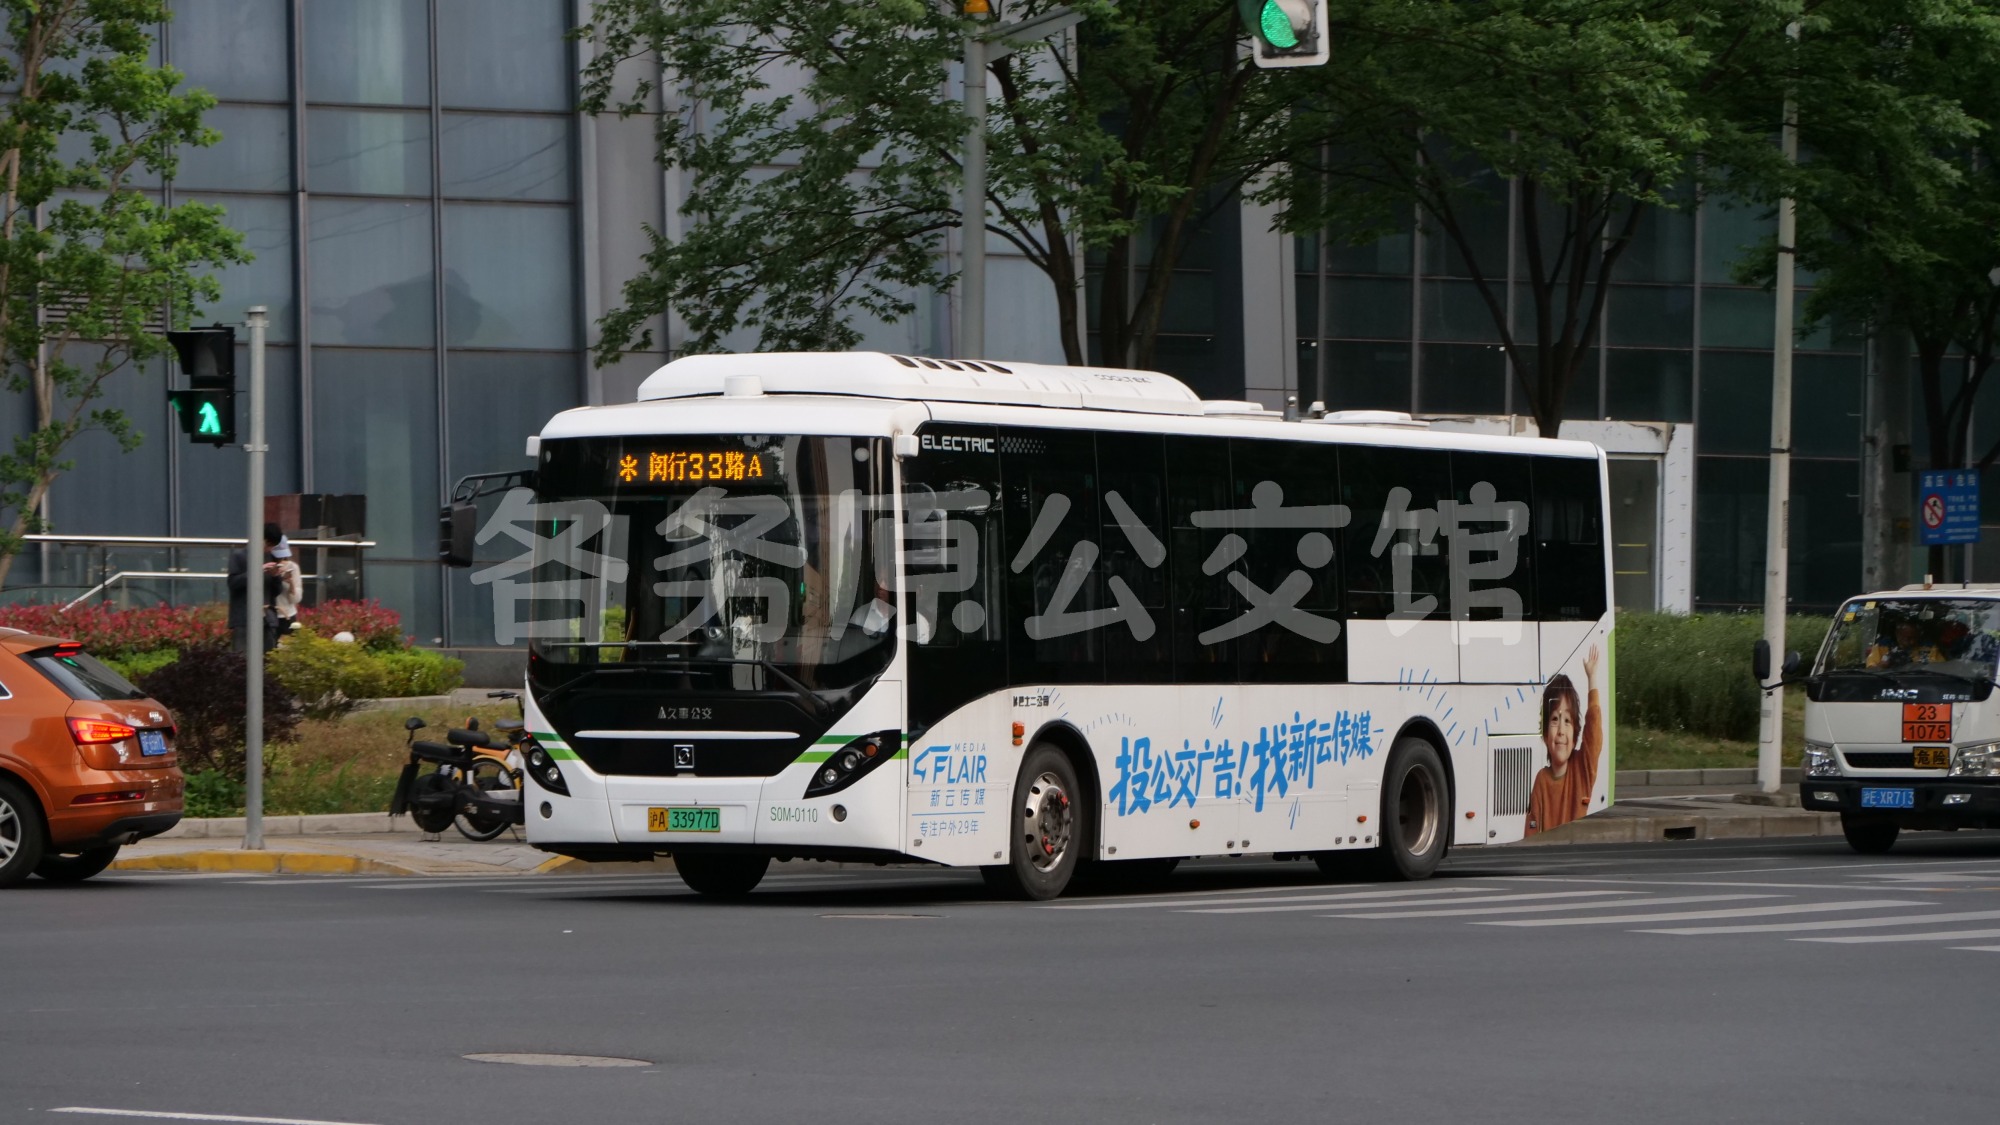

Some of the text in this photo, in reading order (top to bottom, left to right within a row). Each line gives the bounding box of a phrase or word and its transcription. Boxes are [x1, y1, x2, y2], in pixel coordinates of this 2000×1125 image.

[921, 434, 995, 453] ELECTRIC
[649, 451, 763, 481] 闵行33路A
[1917, 705, 1937, 720] 23
[1908, 724, 1946, 739] 1075
[954, 743, 986, 752] MEDIA
[1917, 750, 1946, 765] 危险
[933, 755, 987, 784] FLAIR
[930, 788, 986, 807] 新云传媒
[920, 820, 979, 837] 专注户外29年
